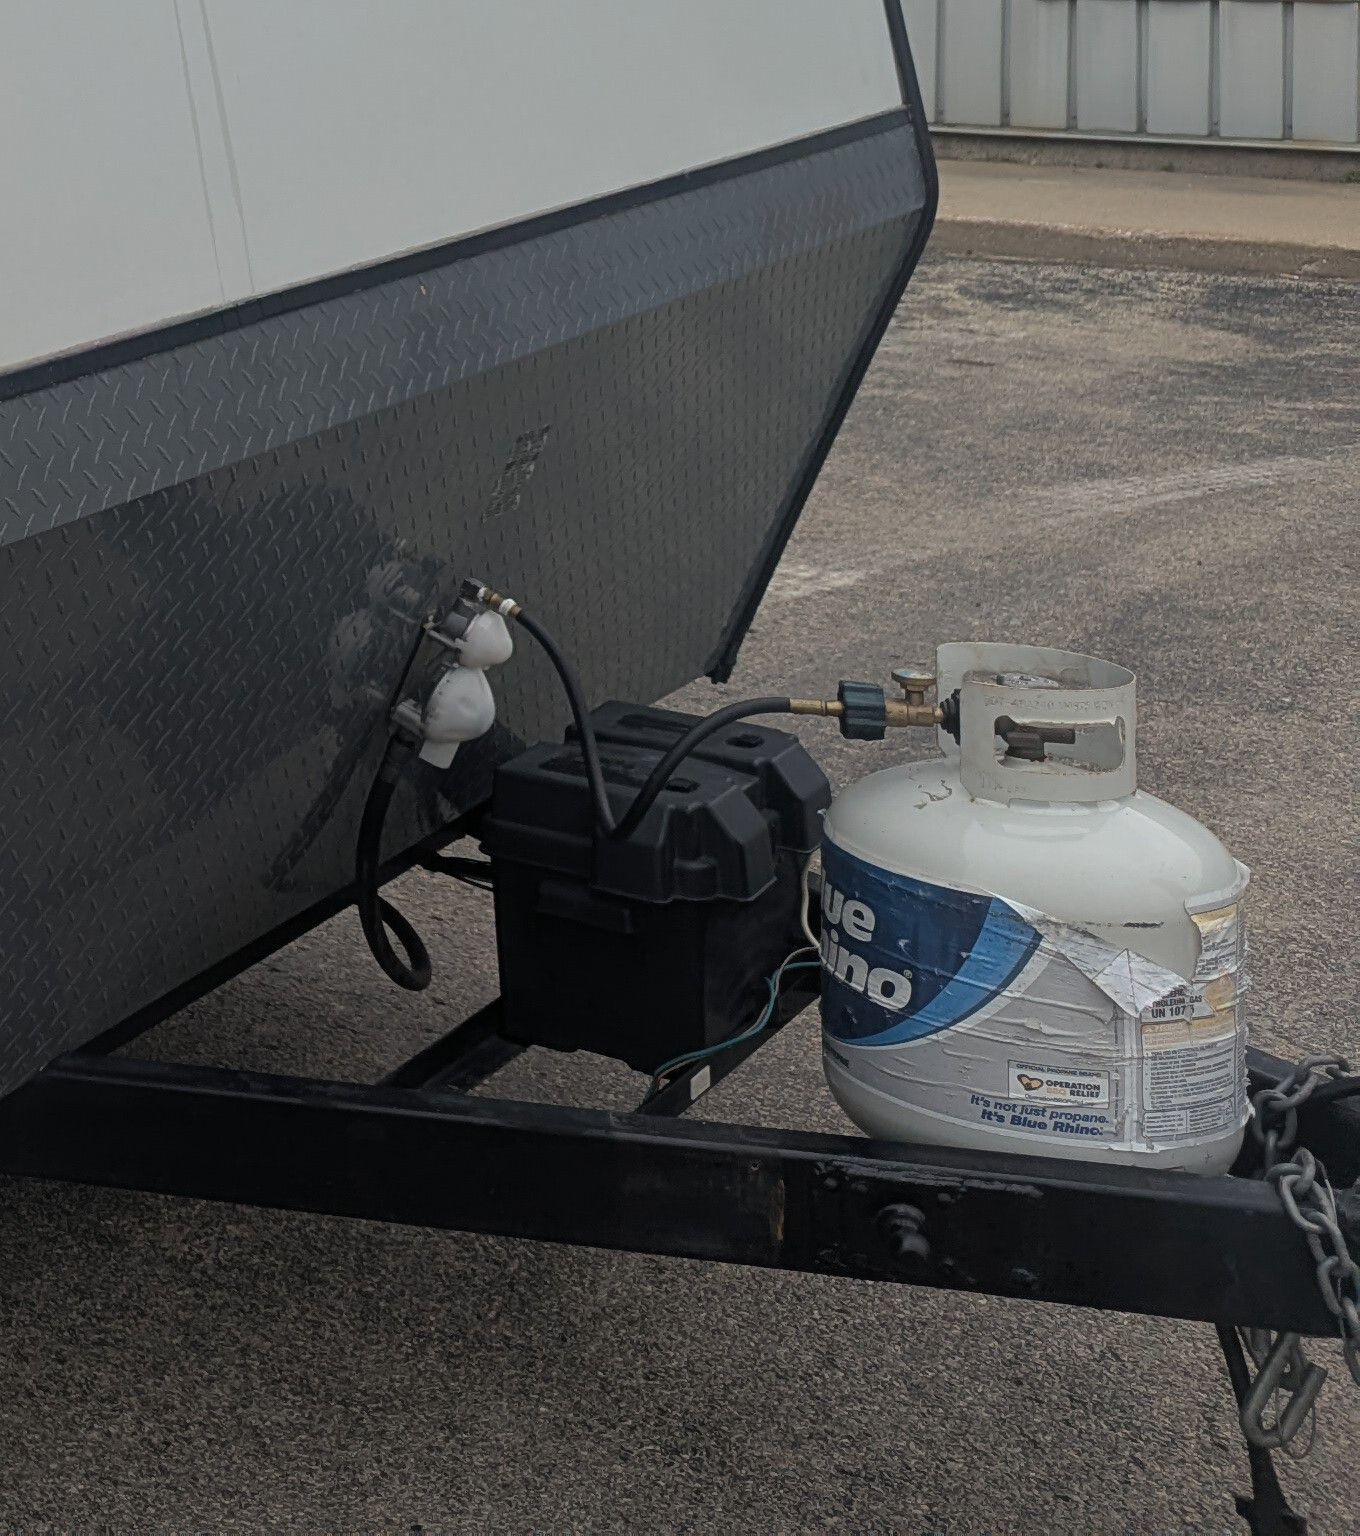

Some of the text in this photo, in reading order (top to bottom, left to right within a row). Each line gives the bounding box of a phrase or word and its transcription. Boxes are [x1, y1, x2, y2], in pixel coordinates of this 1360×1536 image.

[822, 870, 876, 942] ue
[821, 928, 912, 1010] ino
[1151, 1008, 1166, 1018] UN
[1046, 1079, 1100, 1091] OPERATION
[1070, 1089, 1100, 1098] RELIEF
[970, 1094, 1110, 1124] It's not just propane.
[981, 1109, 1006, 1123] It's
[1010, 1114, 1048, 1130] Blue
